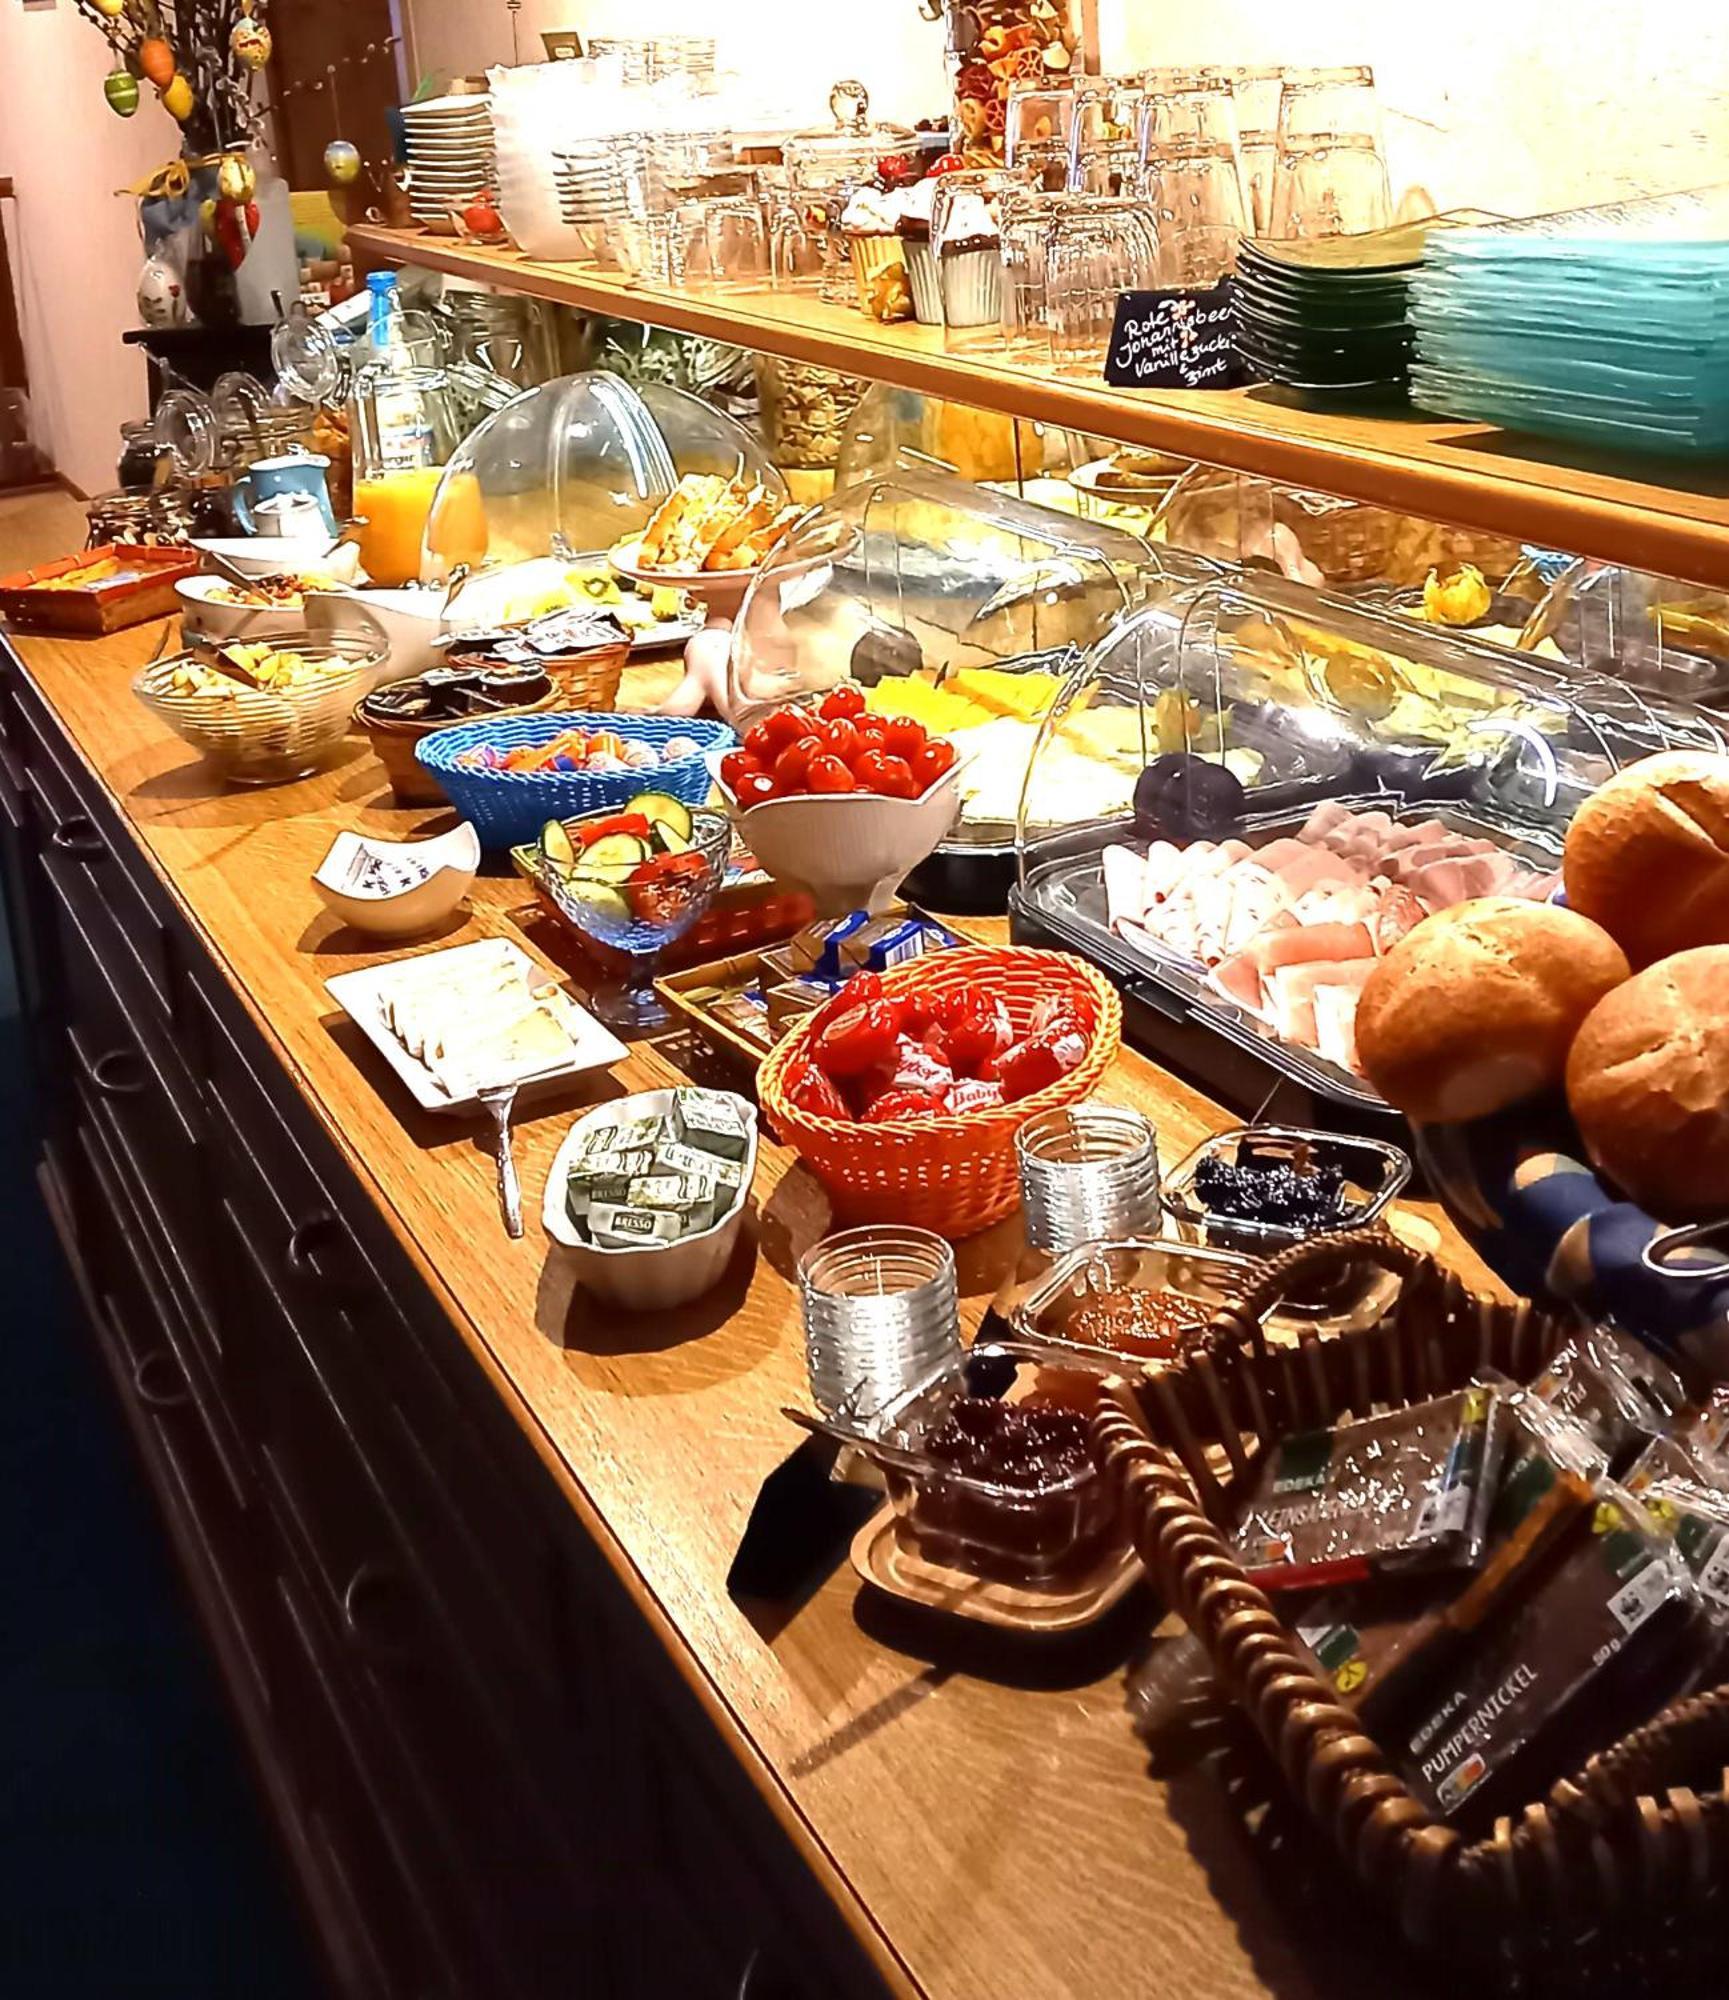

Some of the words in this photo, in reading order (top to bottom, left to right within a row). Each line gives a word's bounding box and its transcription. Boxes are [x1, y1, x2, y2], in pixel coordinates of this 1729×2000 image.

[1124, 309, 1170, 341] Rote
[1152, 337, 1179, 358] mit
[614, 1214, 652, 1230] BRESSO
[1272, 1473, 1326, 1494] EDEKA
[1409, 1690, 1468, 1756] EDEKA
[1421, 1663, 1538, 1783] PUMPERNICKEL
